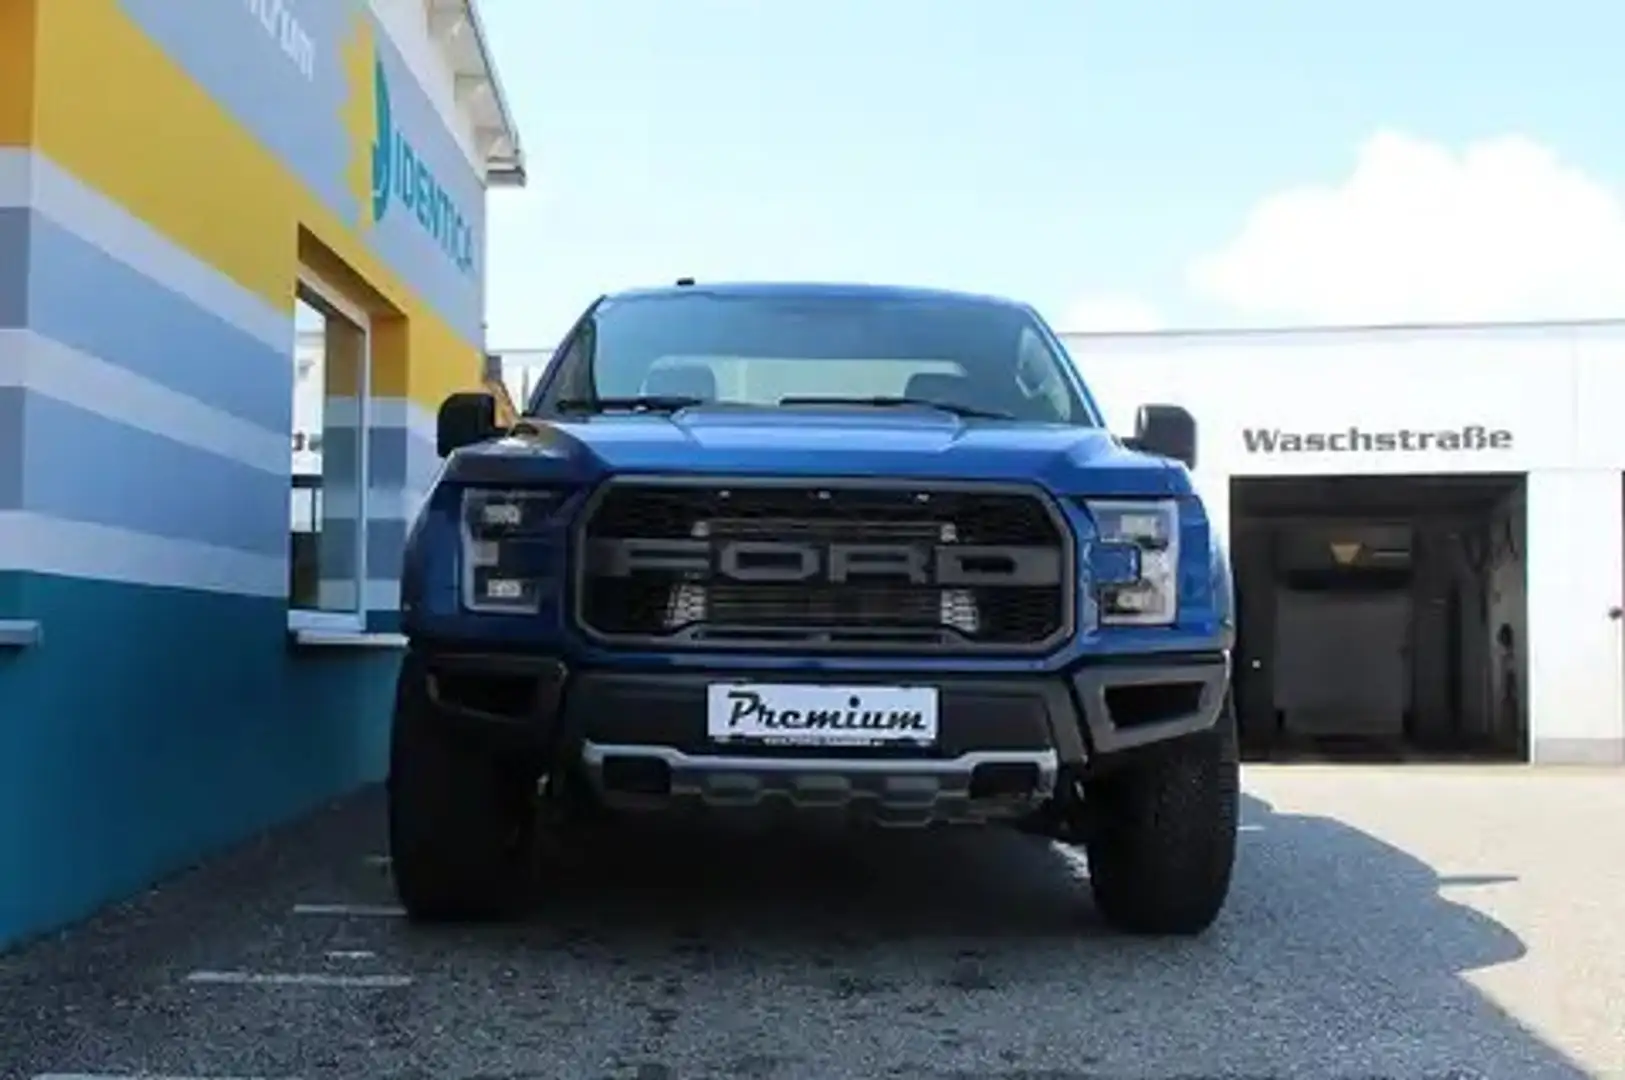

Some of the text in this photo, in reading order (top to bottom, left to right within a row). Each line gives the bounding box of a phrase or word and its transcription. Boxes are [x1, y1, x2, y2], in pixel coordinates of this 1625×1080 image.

[1242, 426, 1513, 453] Waschstraße
[592, 538, 1061, 586] FORD
[727, 690, 926, 730] Premium
